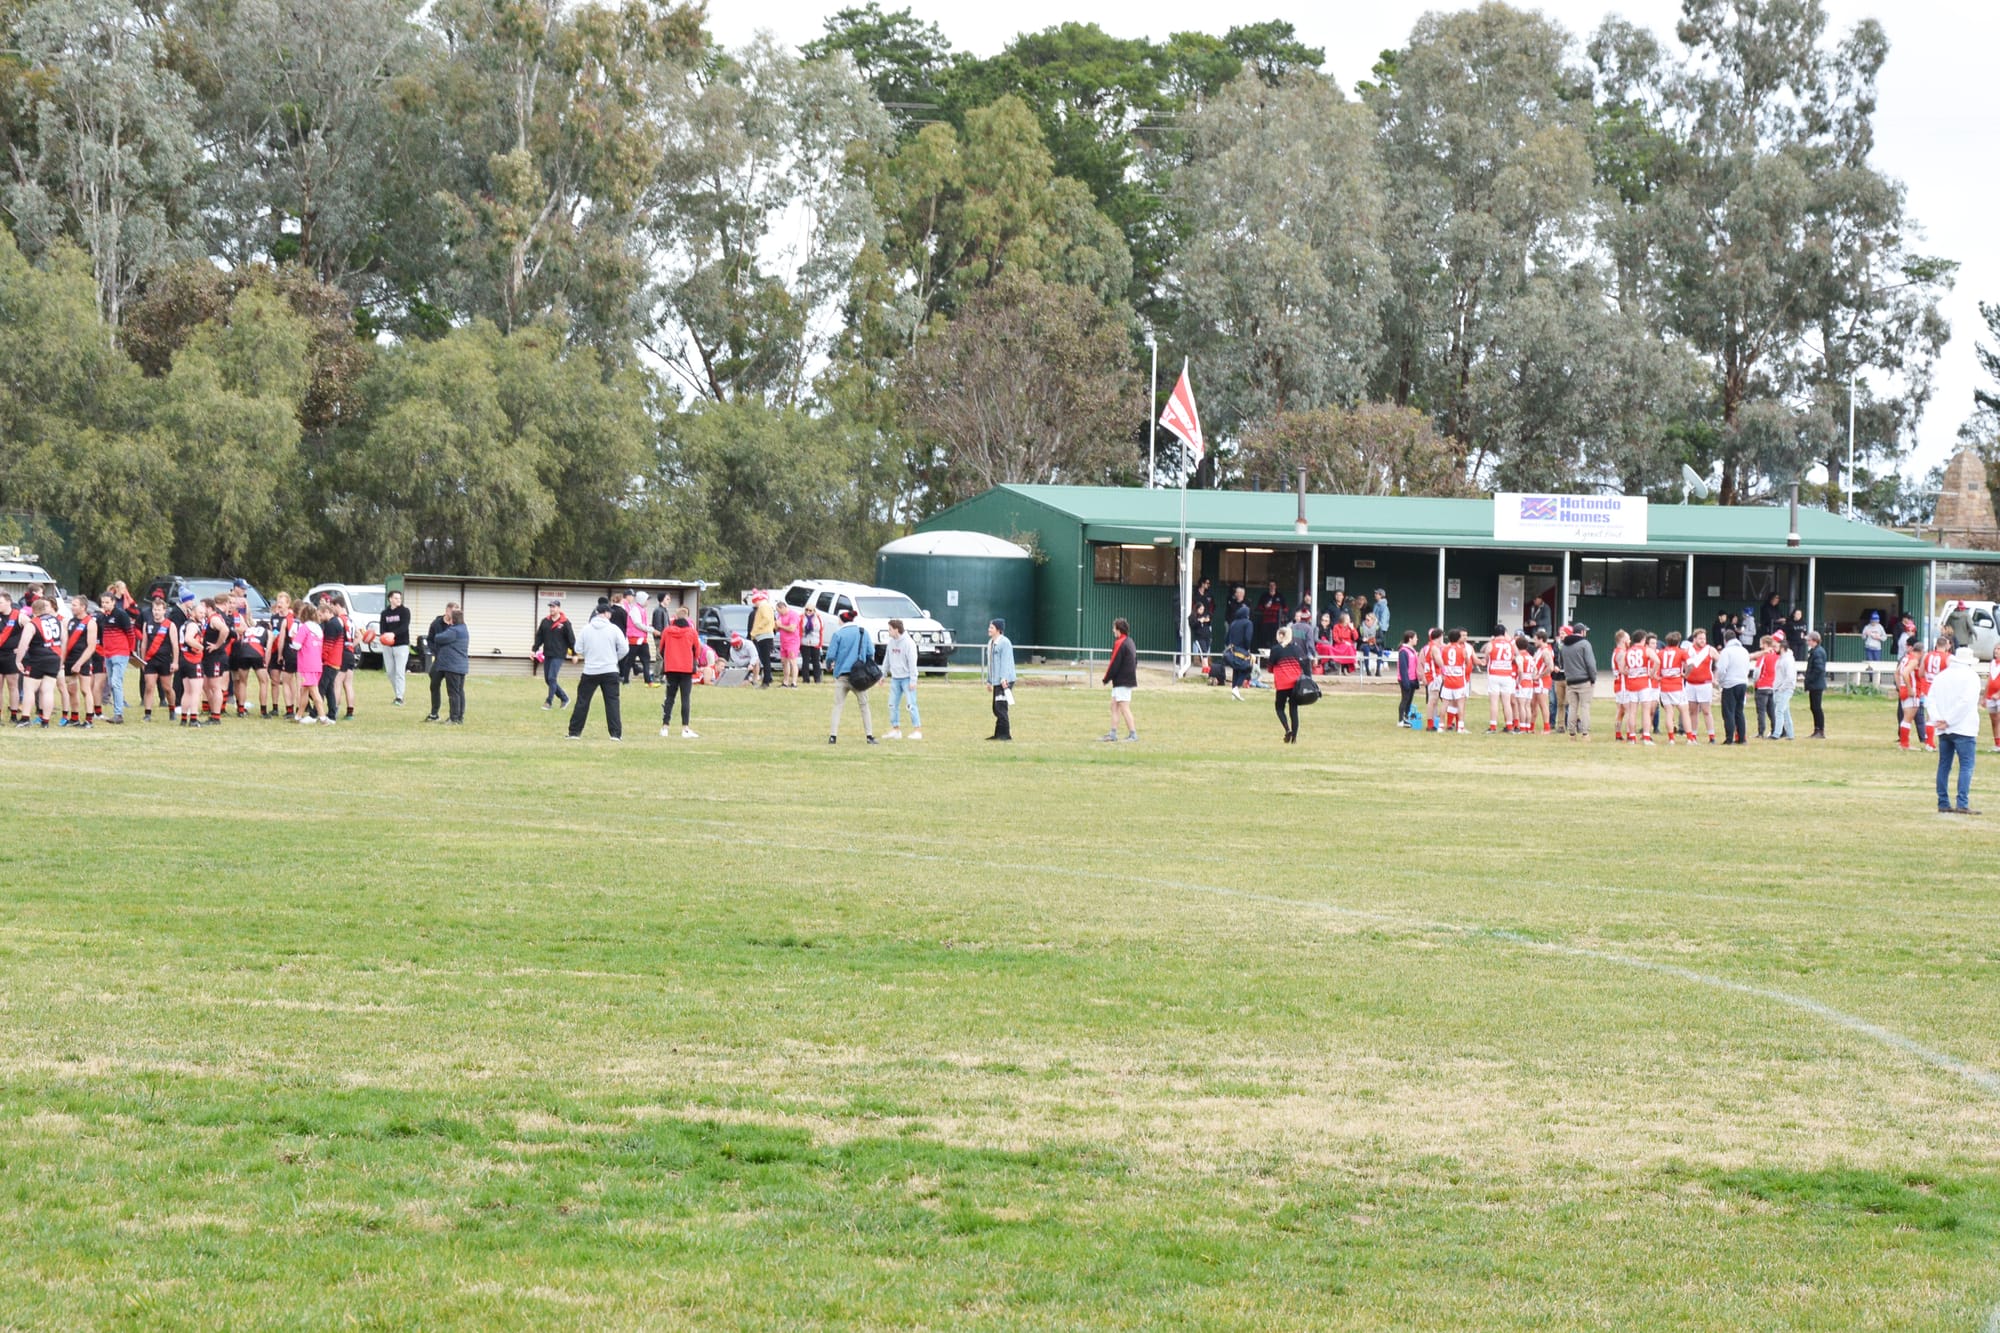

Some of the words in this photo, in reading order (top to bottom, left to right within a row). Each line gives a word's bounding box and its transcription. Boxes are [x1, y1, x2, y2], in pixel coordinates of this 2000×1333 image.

[1560, 497, 1621, 510] Hotondo
[1560, 511, 1611, 523] Homes
[41, 617, 60, 640] 65
[1447, 648, 1457, 666] 9
[1495, 643, 1512, 660] 73
[1627, 649, 1644, 667] 68
[1663, 650, 1676, 668] 17
[1927, 654, 1941, 674] 19
